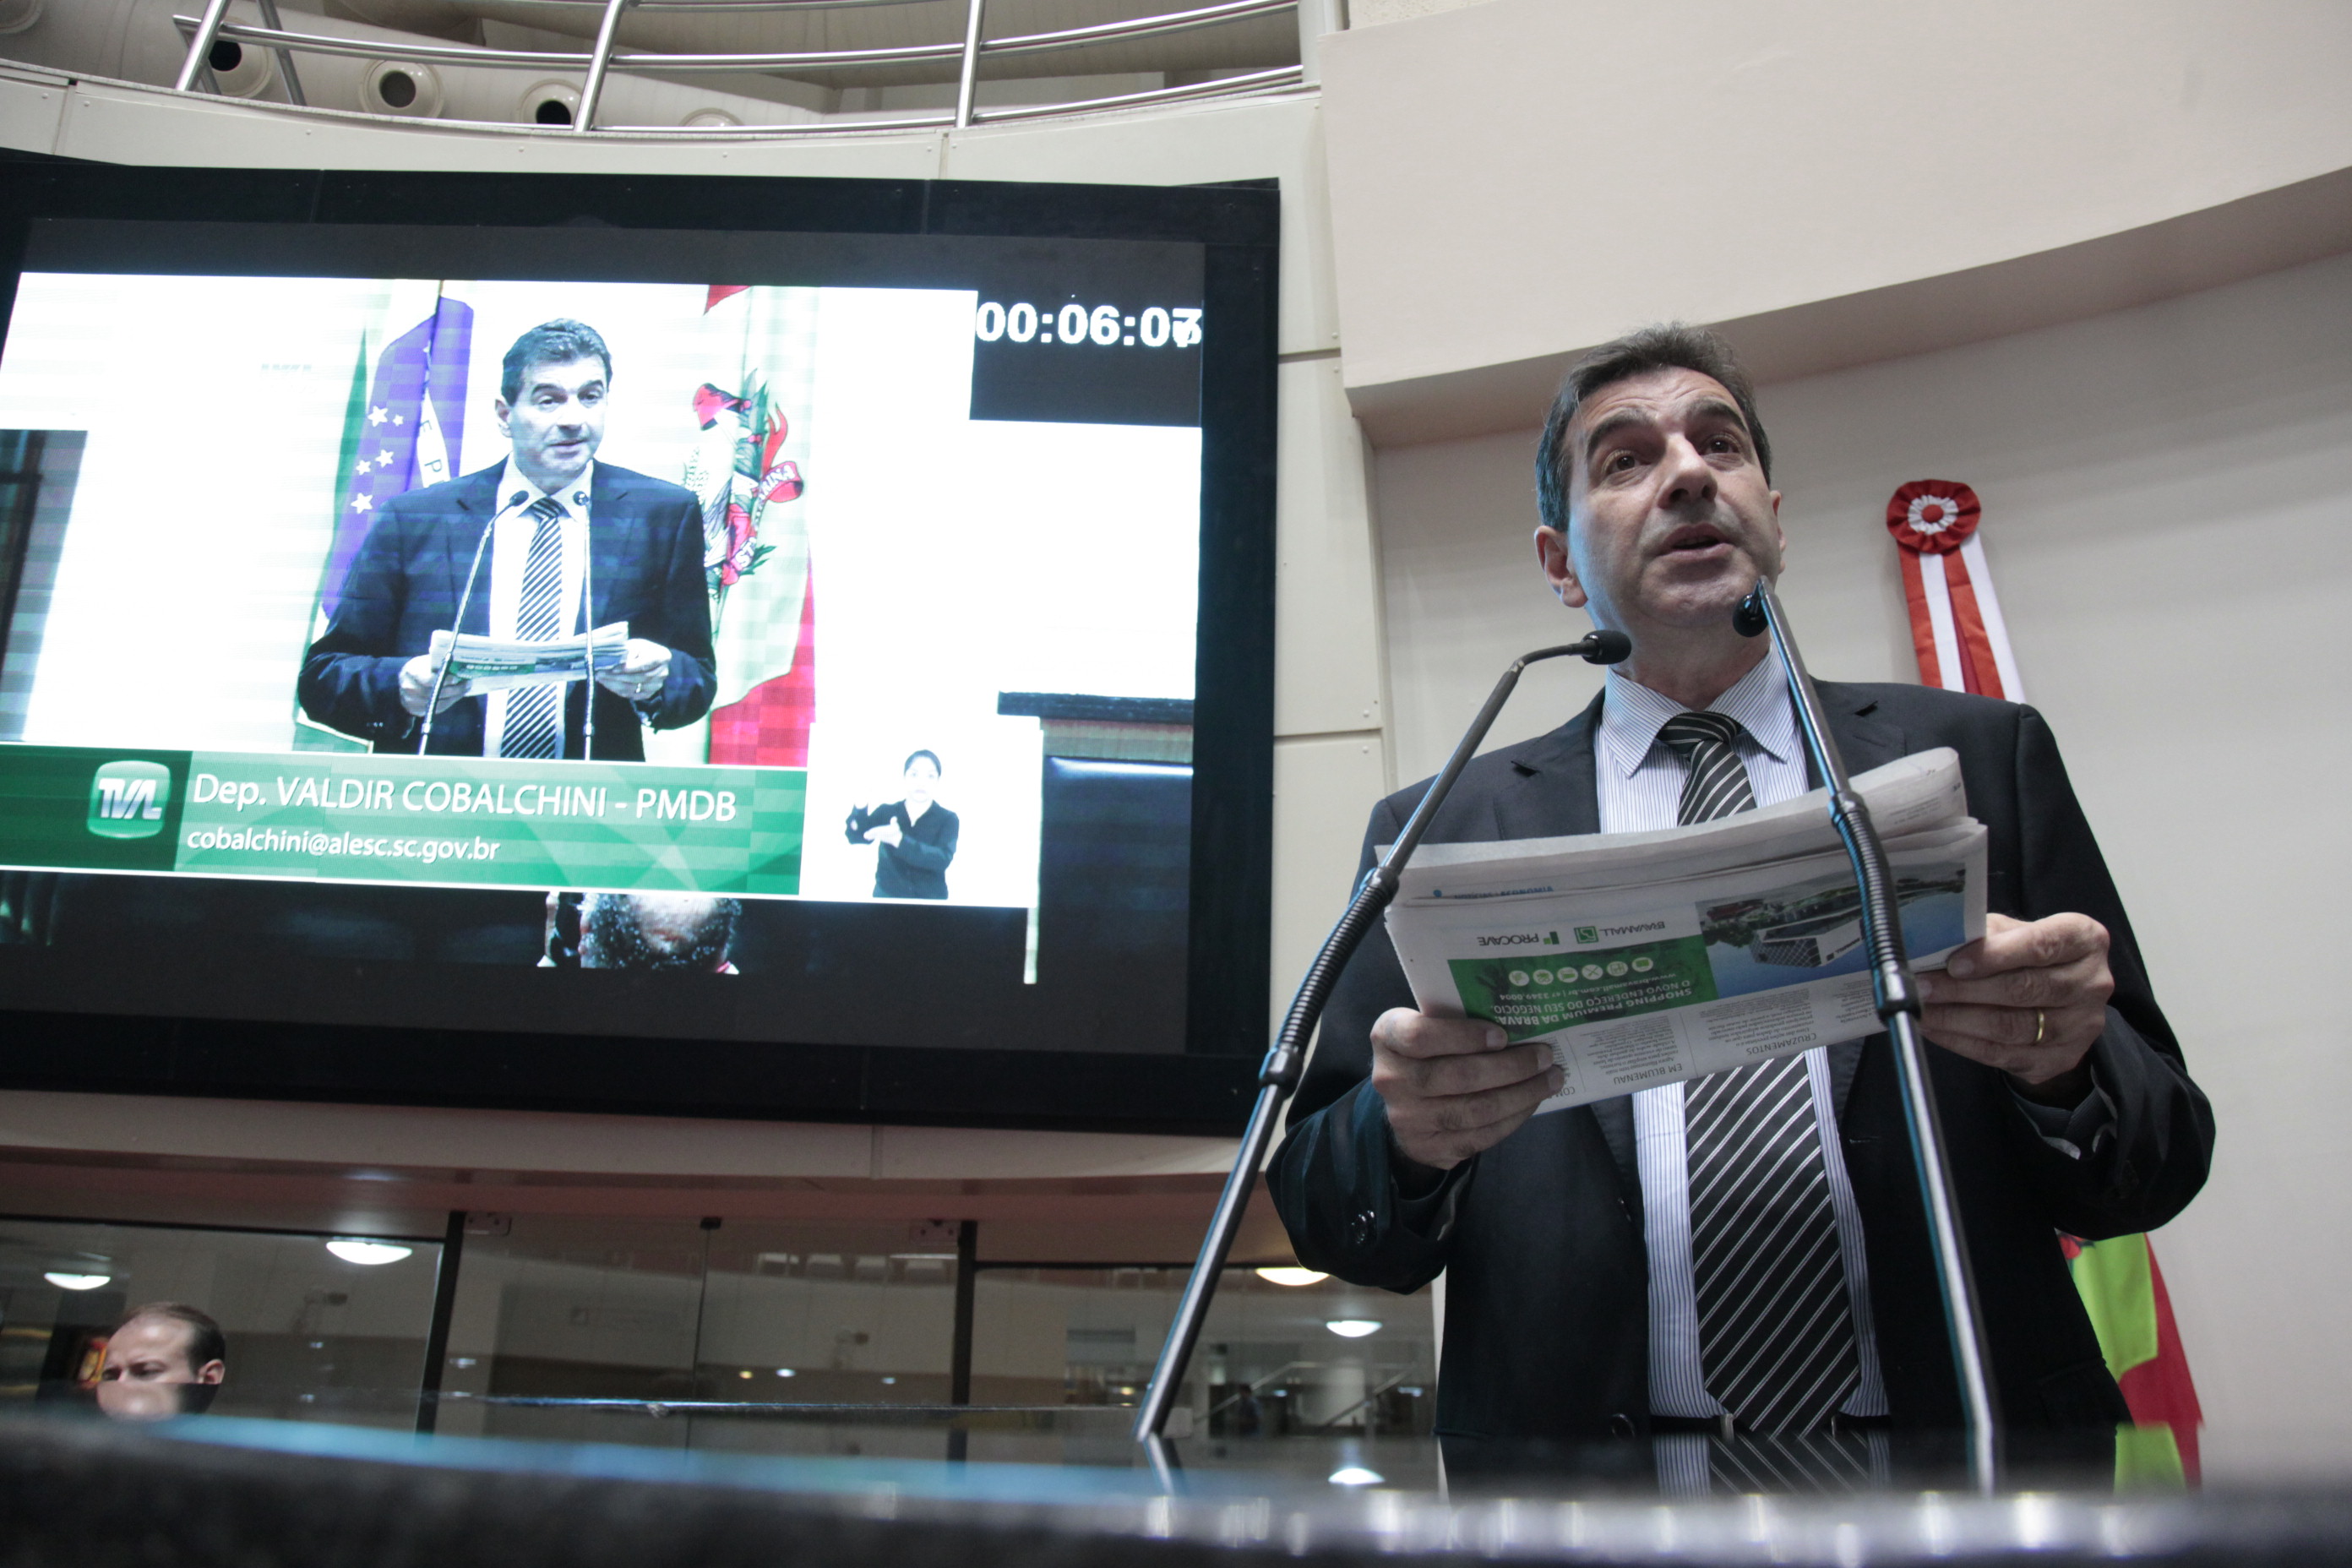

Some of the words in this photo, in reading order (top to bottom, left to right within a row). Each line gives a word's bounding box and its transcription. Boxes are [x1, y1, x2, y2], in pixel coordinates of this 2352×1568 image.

[193, 773, 267, 812] Dep.
[276, 776, 395, 810] VALDIR
[402, 781, 607, 817] COBALCHINI
[635, 788, 738, 822] PMDB
[187, 826, 501, 864] cobalchini@alesc.sc.gov.br
[1599, 920, 1666, 937] BRAVAMALL
[1476, 934, 1539, 946] PROCAVE
[1586, 985, 1644, 1007] ENDEREÇO
[1646, 981, 1678, 994] NOVO
[1565, 1000, 1583, 1010] DO
[1625, 987, 1692, 1008] SHOPPING
[1544, 1002, 1564, 1014] SEU
[1561, 1001, 1622, 1020] PREMIUM
[1541, 1014, 1560, 1025] DA
[1745, 1032, 1816, 1055] CRUZAMENTOS
[1613, 1064, 1666, 1086] BLUMENAU
[1667, 1063, 1683, 1074] EM
